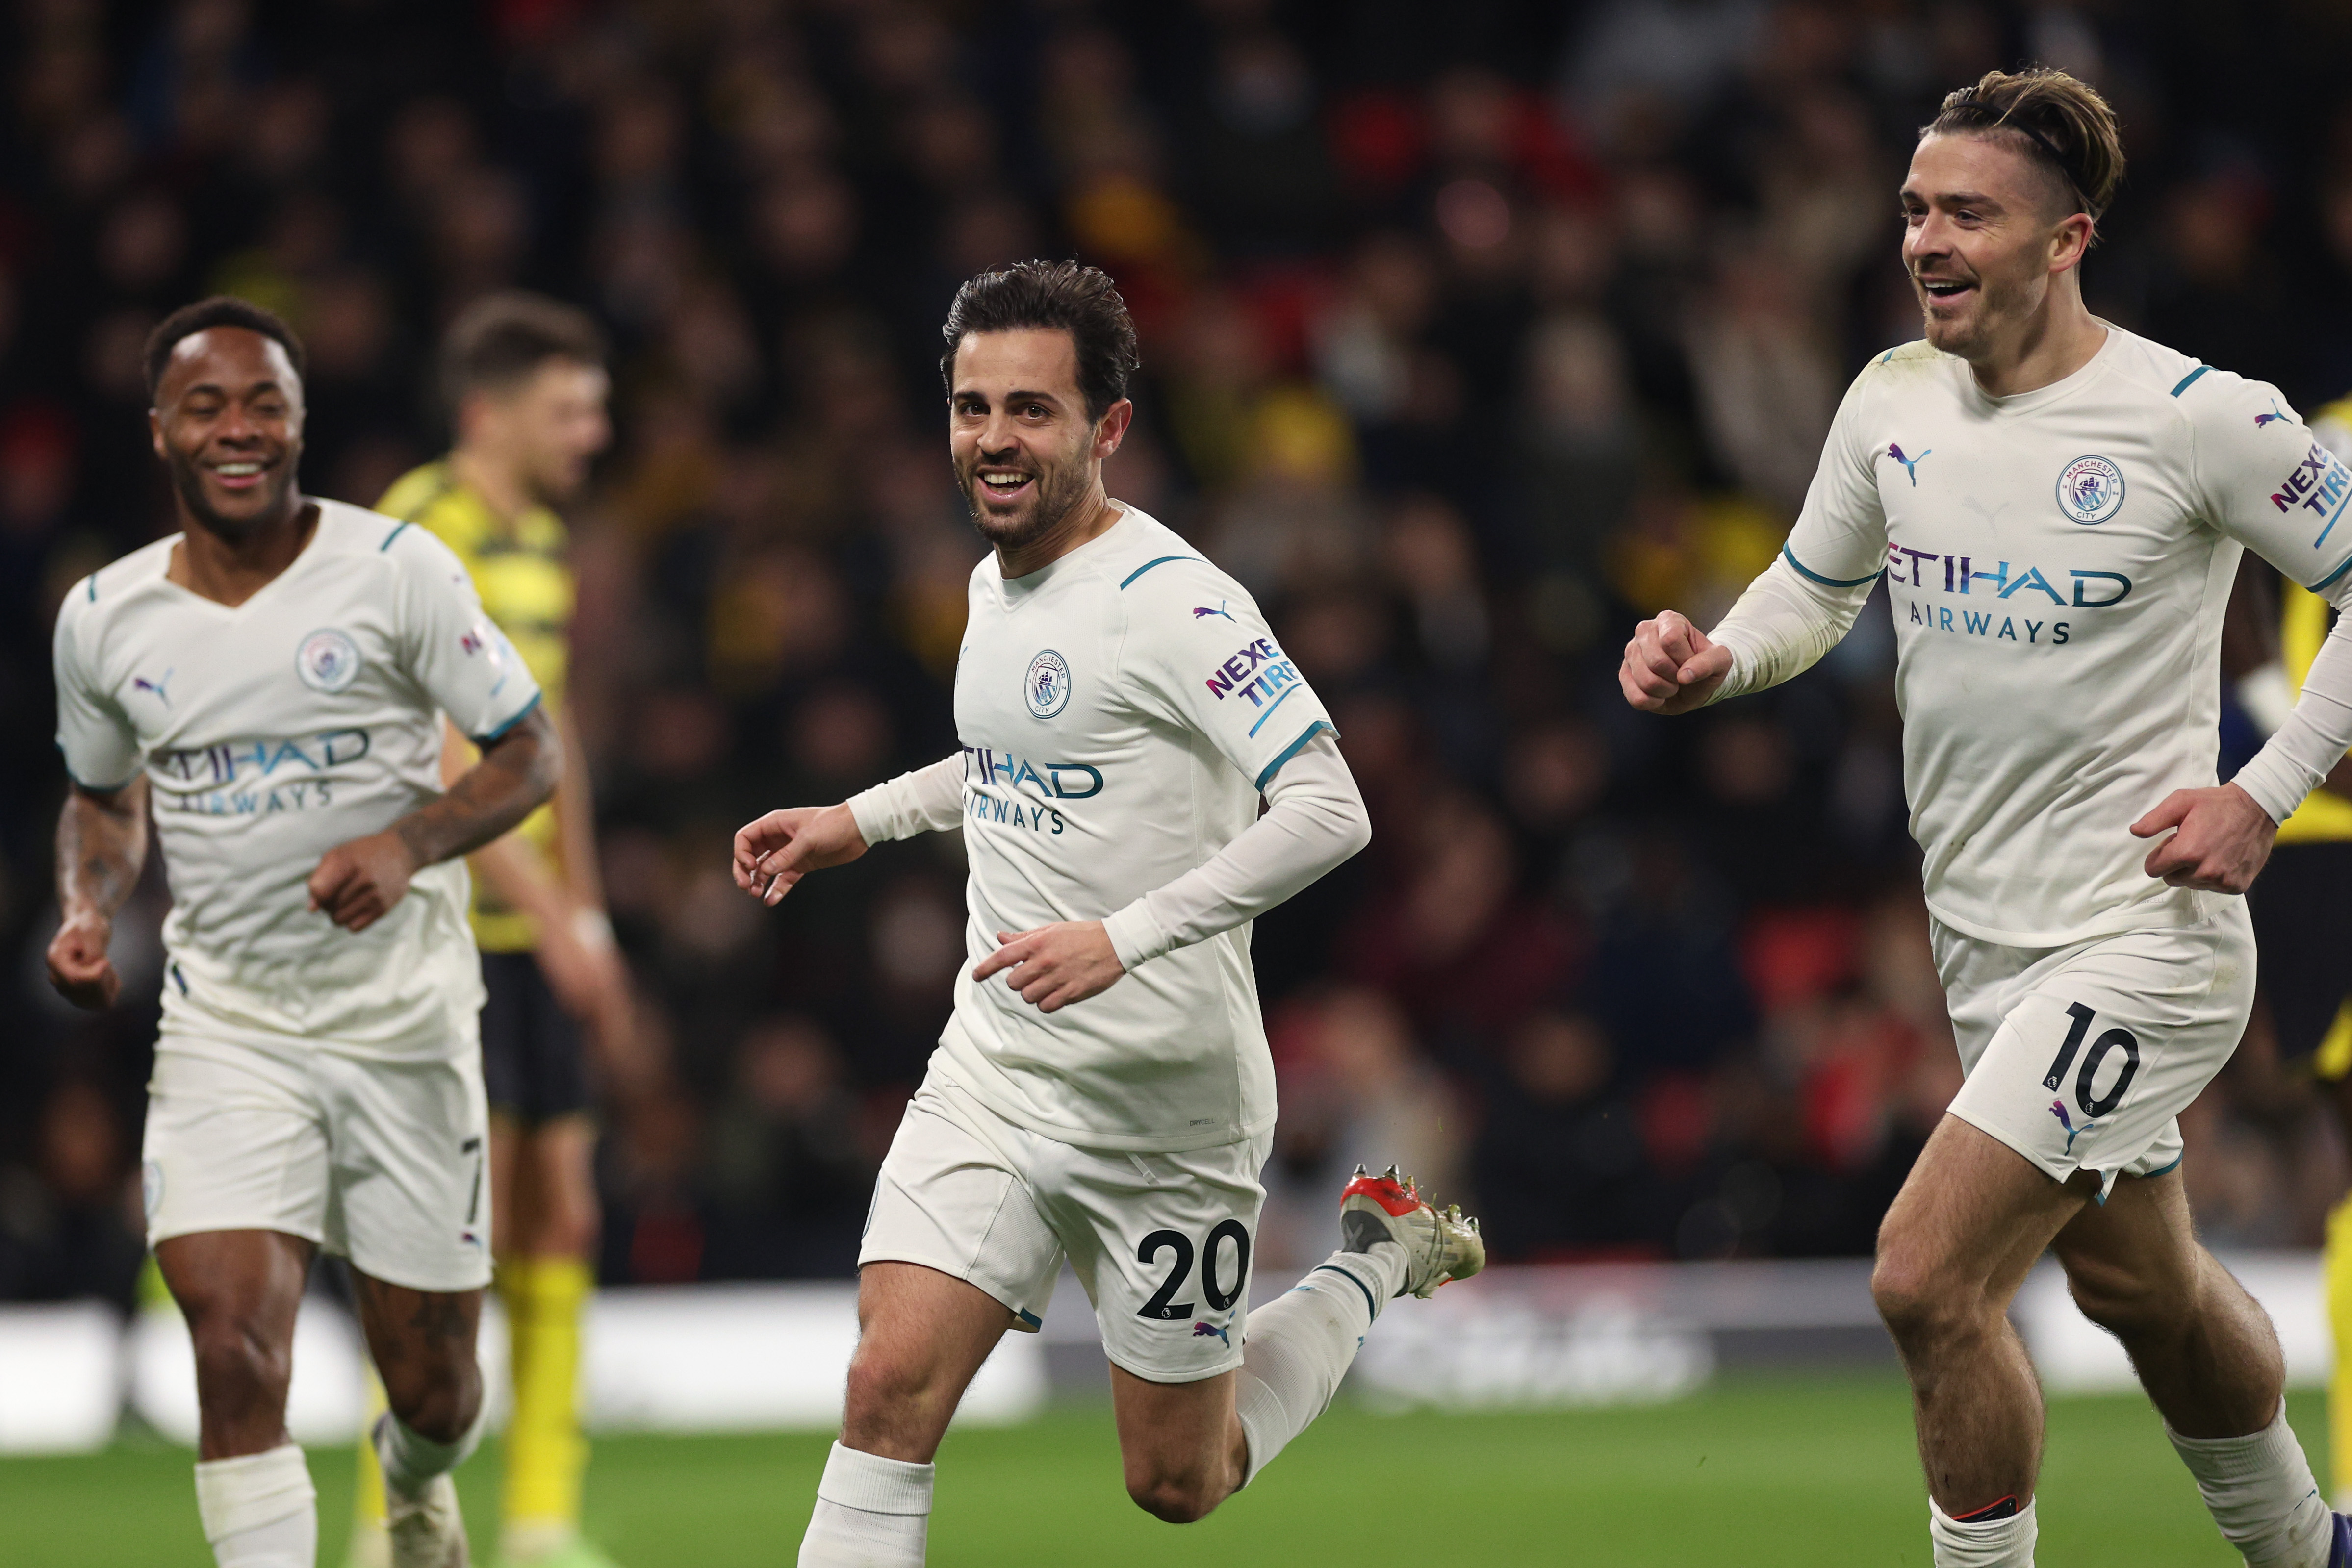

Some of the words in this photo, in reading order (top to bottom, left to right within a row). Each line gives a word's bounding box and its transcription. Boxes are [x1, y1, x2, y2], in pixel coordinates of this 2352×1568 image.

[2066, 460, 2118, 484] MANCHESTER
[2271, 443, 2328, 513] NEXE
[2076, 511, 2096, 520] CITY
[1888, 541, 2132, 607] ETIHAD
[1910, 601, 2070, 644] AIRWAYS
[1031, 655, 1065, 679] MANCHESTER
[1205, 638, 1280, 700] NEXE
[1238, 661, 1301, 708] TIRE
[153, 728, 369, 784] TIHAD
[962, 745, 1104, 799] TIHAD
[2042, 1001, 2140, 1118] 10
[1189, 1118, 1215, 1126] DRYCELL
[1136, 1219, 1250, 1320] 20
